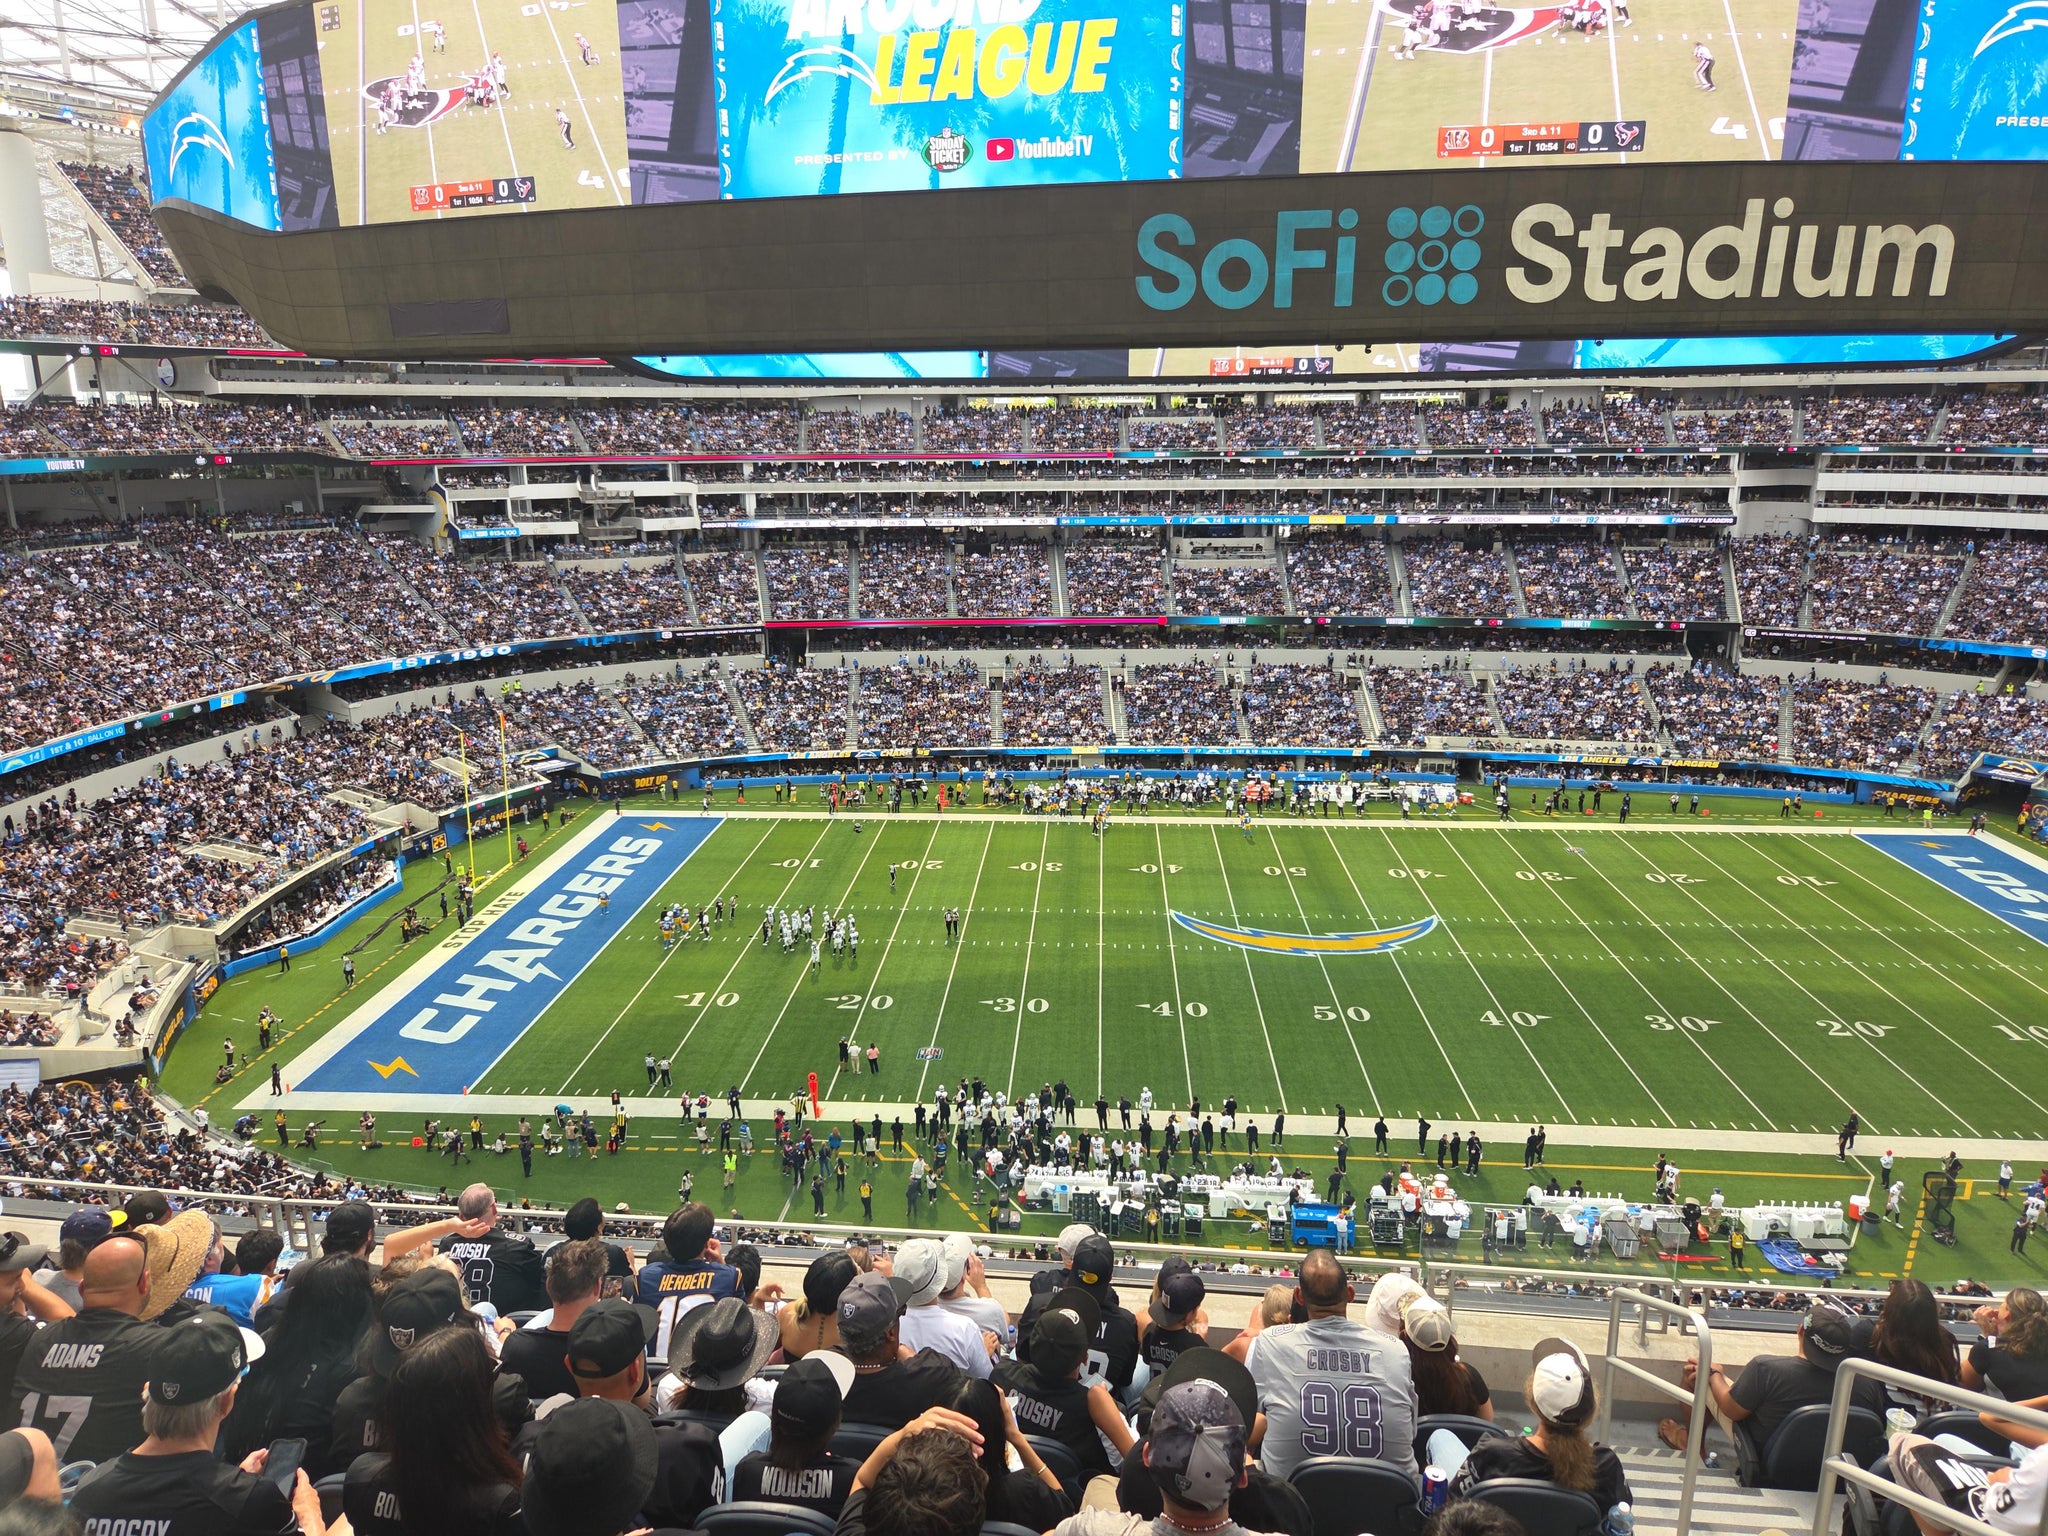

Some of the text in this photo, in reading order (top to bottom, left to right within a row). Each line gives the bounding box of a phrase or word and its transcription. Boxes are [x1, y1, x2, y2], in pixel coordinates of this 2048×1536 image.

[870, 18, 1118, 105] LEAGUE
[1480, 128, 1495, 148] 0
[1521, 125, 1561, 136] 3RD & 11
[1587, 125, 1603, 145] 0
[930, 135, 965, 151] SUNDAY
[1509, 141, 1559, 153] 1ST 10:54
[1566, 142, 1576, 150] 40
[794, 151, 909, 167] PRESENTED BY
[930, 148, 966, 165] TICKET
[434, 186, 444, 203] 0
[498, 180, 509, 198] 0
[1135, 196, 1957, 311] SoFi Stadium
[1298, 358, 1309, 371] 0
[46, 459, 86, 471] YOUTUBE TV
[391, 645, 513, 672] EST. 1960
[49, 727, 124, 757] 1ST & 10 BALL ON 10
[28, 752, 41, 763] 14
[788, 749, 852, 760] LOS ANGELES
[1559, 755, 1630, 765] LOS ANGELES
[1661, 759, 1720, 769] CHARGERS
[634, 774, 668, 789] BOLT UP
[1873, 790, 1941, 805] CHARGERS
[432, 835, 446, 851] 25
[780, 858, 825, 869] 10
[899, 859, 945, 871] 20
[1019, 861, 1064, 873] 30
[1140, 863, 1184, 874] 40
[1263, 866, 1308, 877] 50
[1387, 868, 1432, 879] 40
[1515, 870, 1564, 882] 30
[1644, 872, 1695, 884] 20
[1776, 875, 1827, 887] 10
[442, 890, 525, 949] STOP HATE
[398, 835, 664, 1045] CHARGERS
[684, 992, 741, 1008] 10
[836, 993, 895, 1011] 20
[993, 997, 1050, 1014] 30
[1152, 1001, 1208, 1018] 40
[1313, 1004, 1372, 1023] 50
[1479, 1010, 1538, 1028] 40
[1644, 1014, 1710, 1033] 30
[1815, 1019, 1886, 1038] 20
[450, 1241, 492, 1260] CROSBY
[453, 1257, 495, 1302] 8
[658, 1272, 715, 1293] HERBERT
[41, 1343, 105, 1370] ADAMS
[1149, 1344, 1180, 1363] CROSBY
[1306, 1349, 1371, 1374] CROSBY
[1007, 1387, 1064, 1430] CROSBY
[19, 1391, 94, 1463] 17
[1299, 1380, 1385, 1460] 98
[760, 1465, 834, 1500] WOODSON
